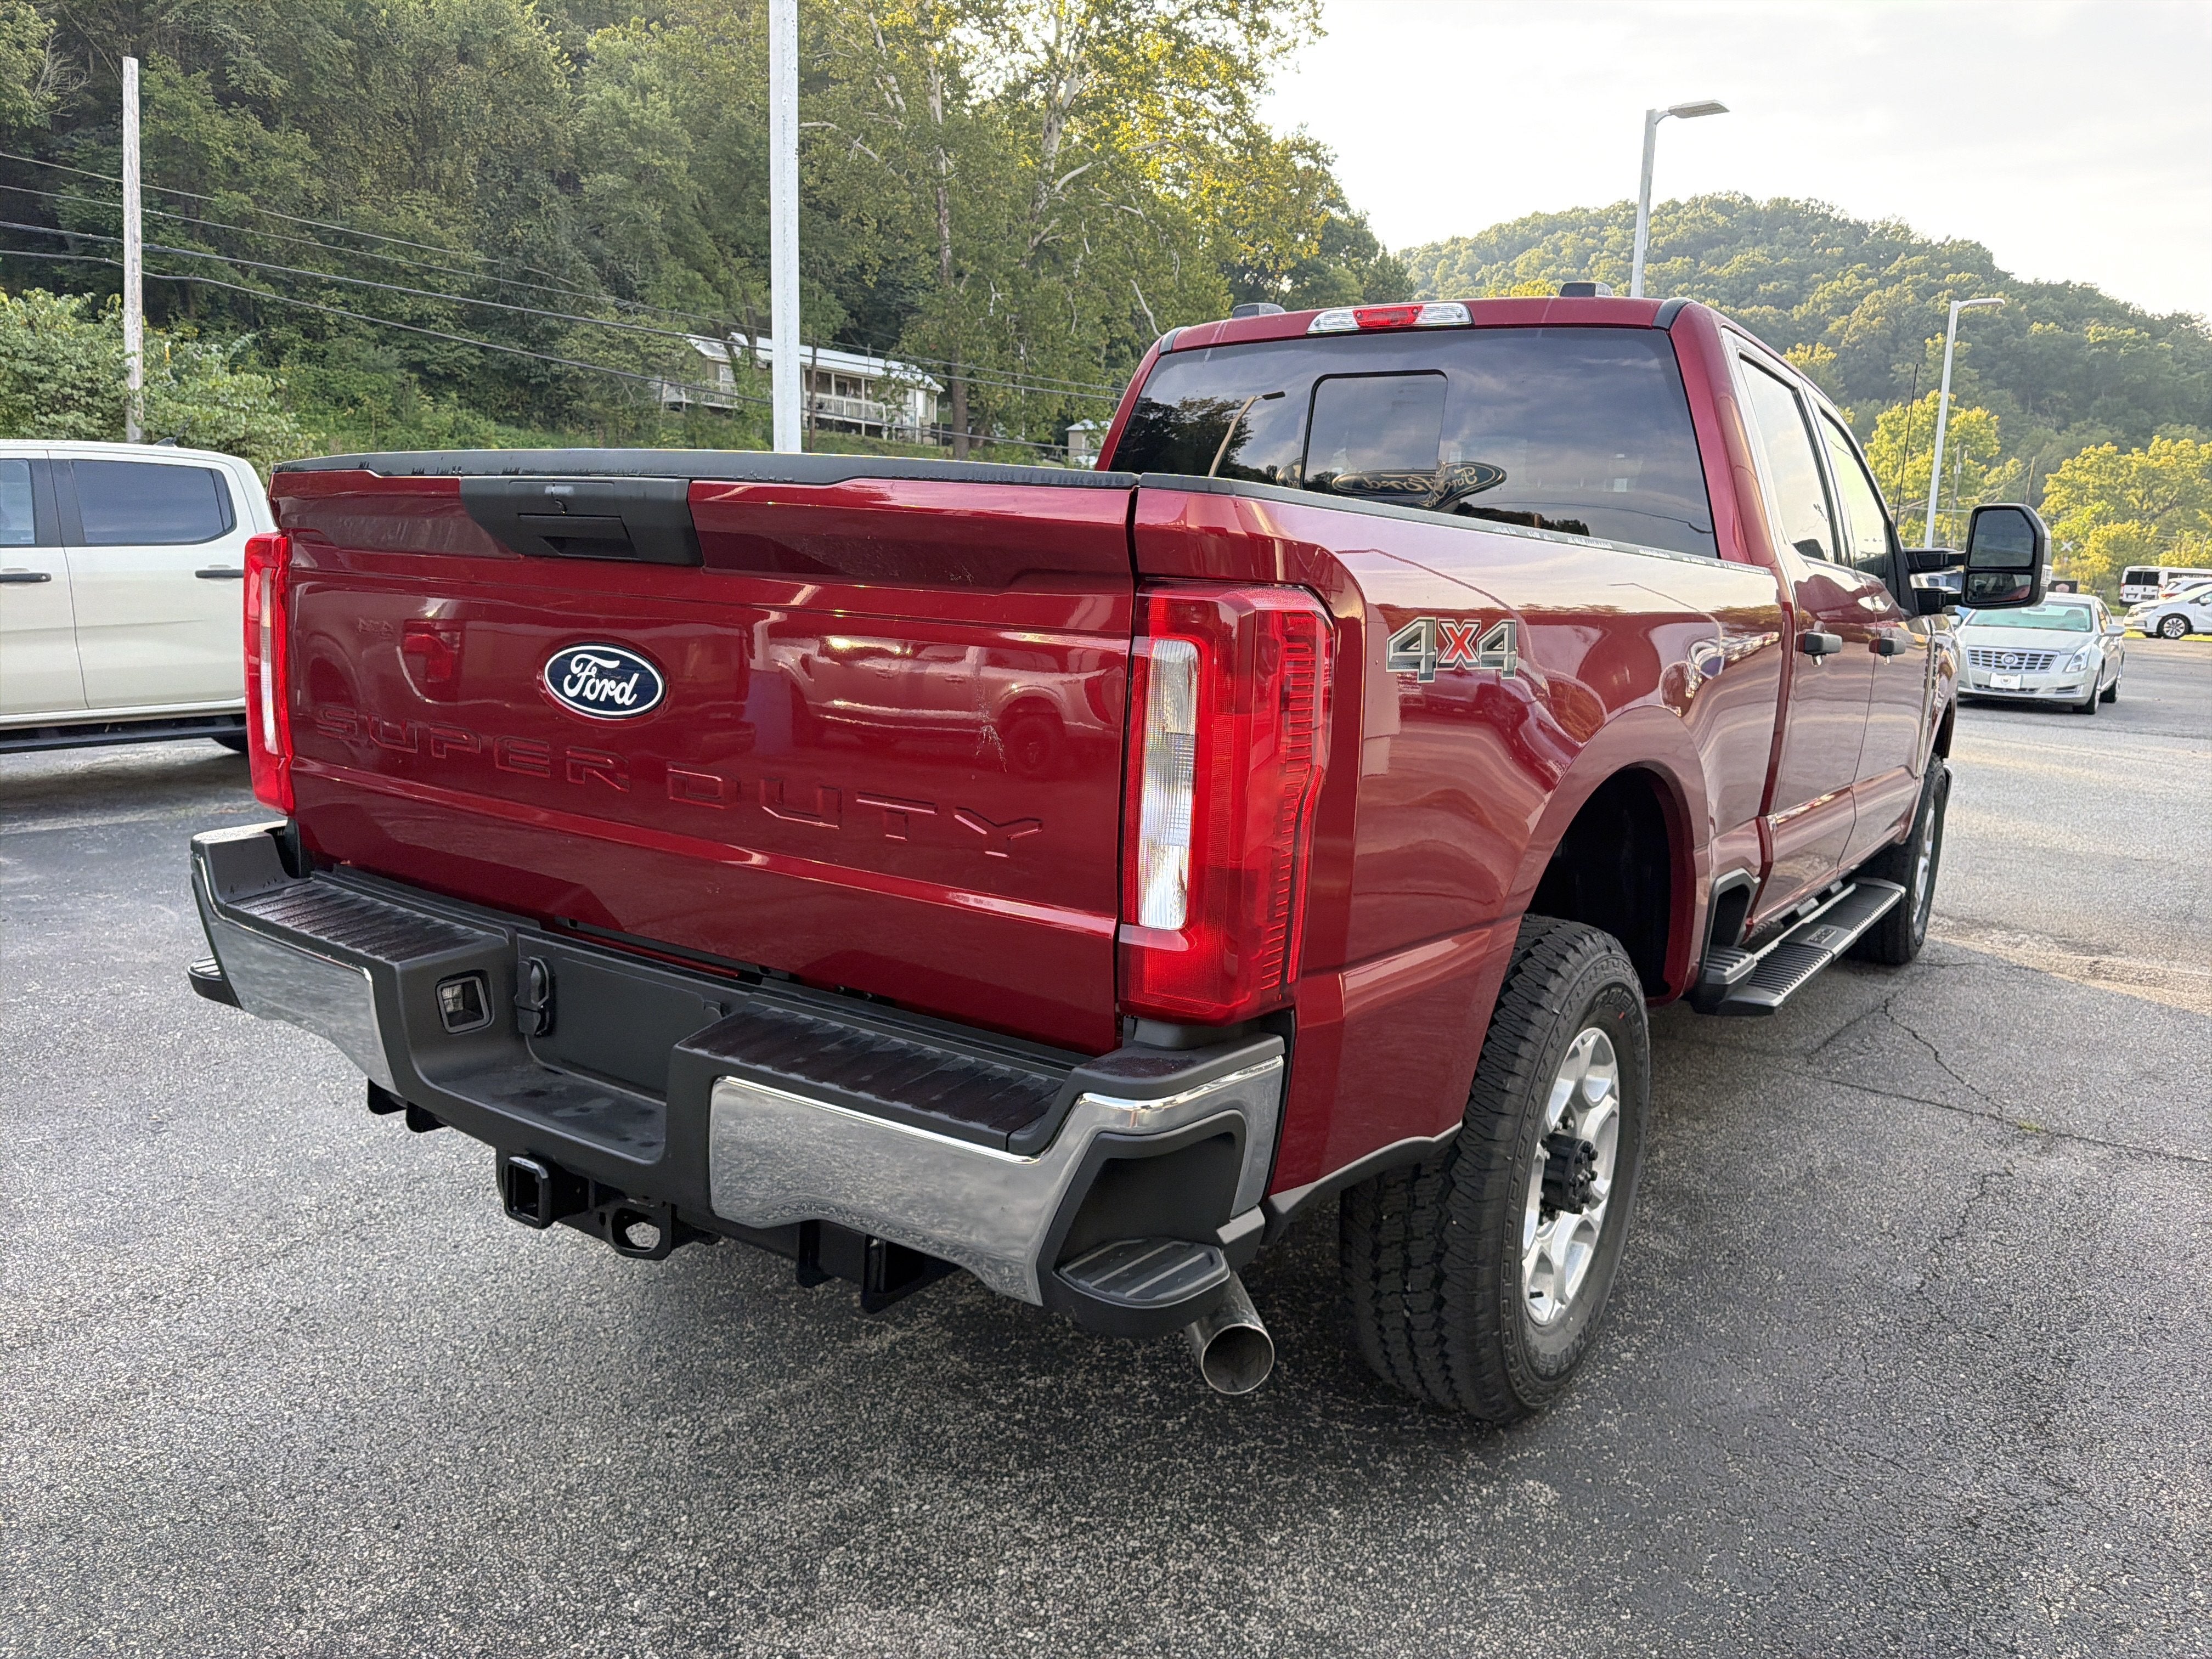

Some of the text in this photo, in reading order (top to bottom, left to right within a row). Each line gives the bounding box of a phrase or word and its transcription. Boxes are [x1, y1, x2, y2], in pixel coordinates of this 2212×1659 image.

[563, 653, 639, 706] Ford
[314, 703, 1042, 858] SUPER DUTY
